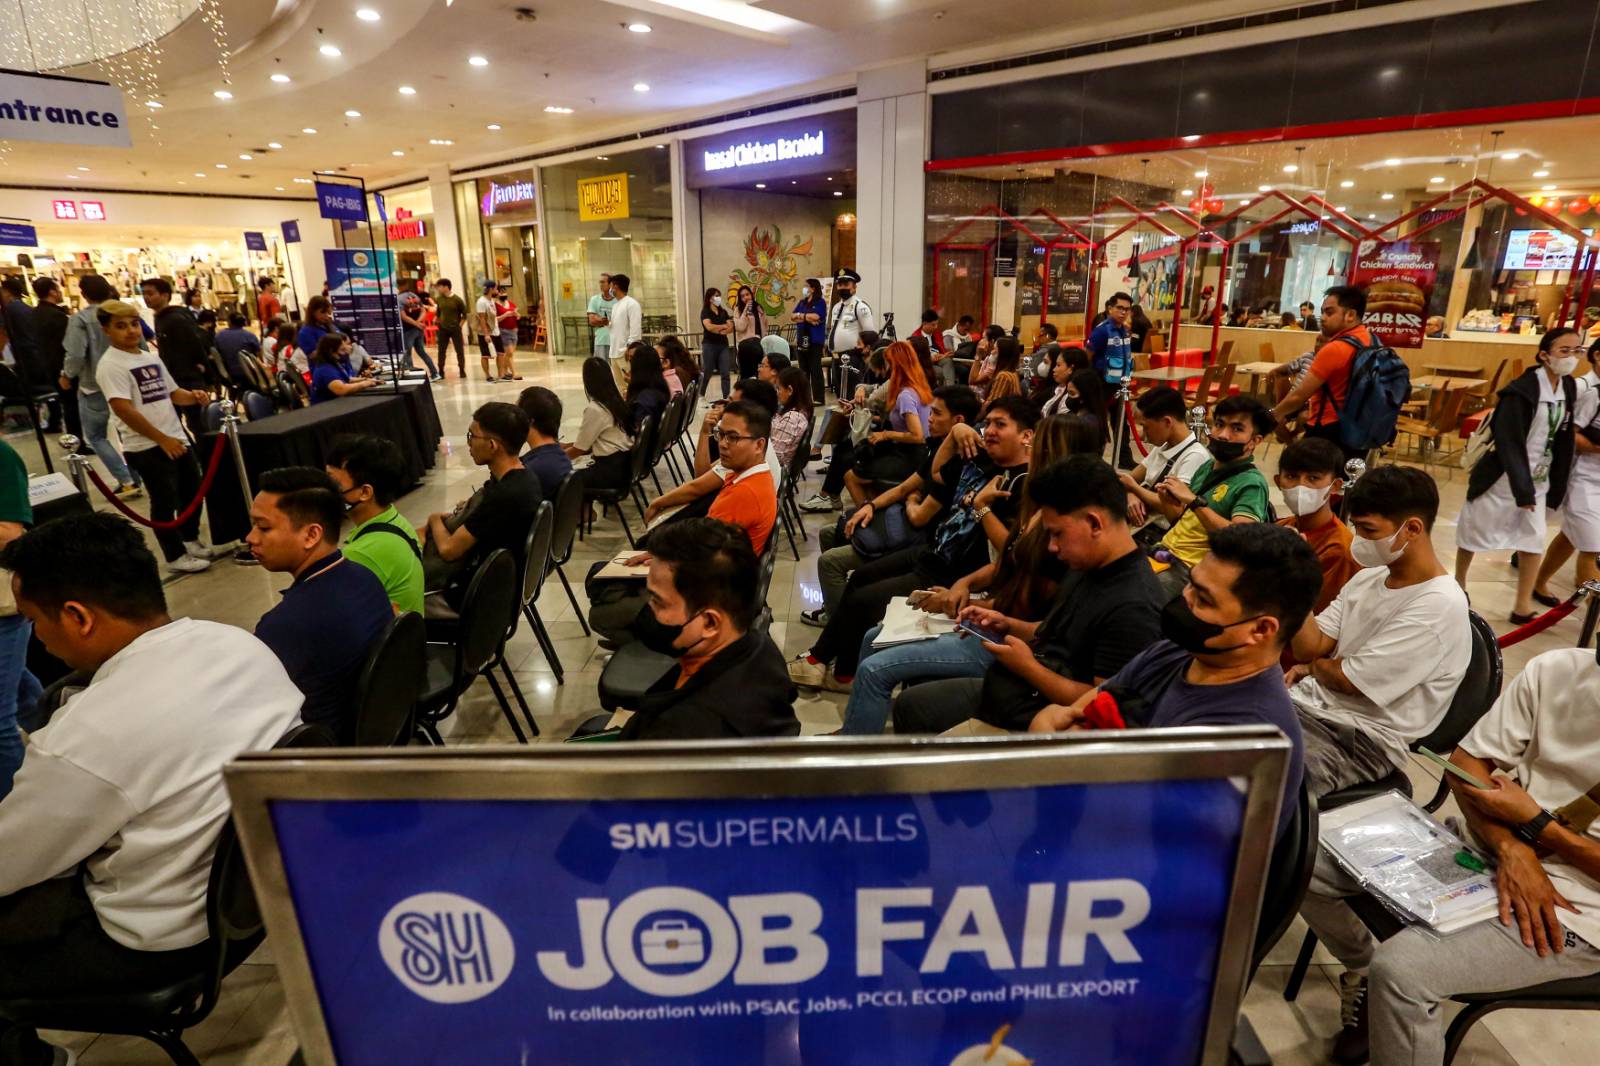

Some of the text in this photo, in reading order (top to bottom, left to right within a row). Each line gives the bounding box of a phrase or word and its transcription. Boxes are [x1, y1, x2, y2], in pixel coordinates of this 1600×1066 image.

[0, 99, 119, 128] ntrance
[324, 195, 362, 211] PAG-IBIG
[1393, 261, 1435, 270] Sandwich
[609, 813, 919, 850] SM SUPERMALLS
[536, 878, 1152, 997] JOB FAIR
[547, 1006, 566, 1021] In
[569, 1004, 695, 1021] collaboration
[698, 1002, 741, 1016] with
[745, 1000, 800, 1015] PSAC
[857, 991, 908, 1007] PCCI,
[911, 988, 967, 1004] ECOP
[970, 987, 1006, 1003] and
[1010, 979, 1140, 1000] PHILEXPORT
